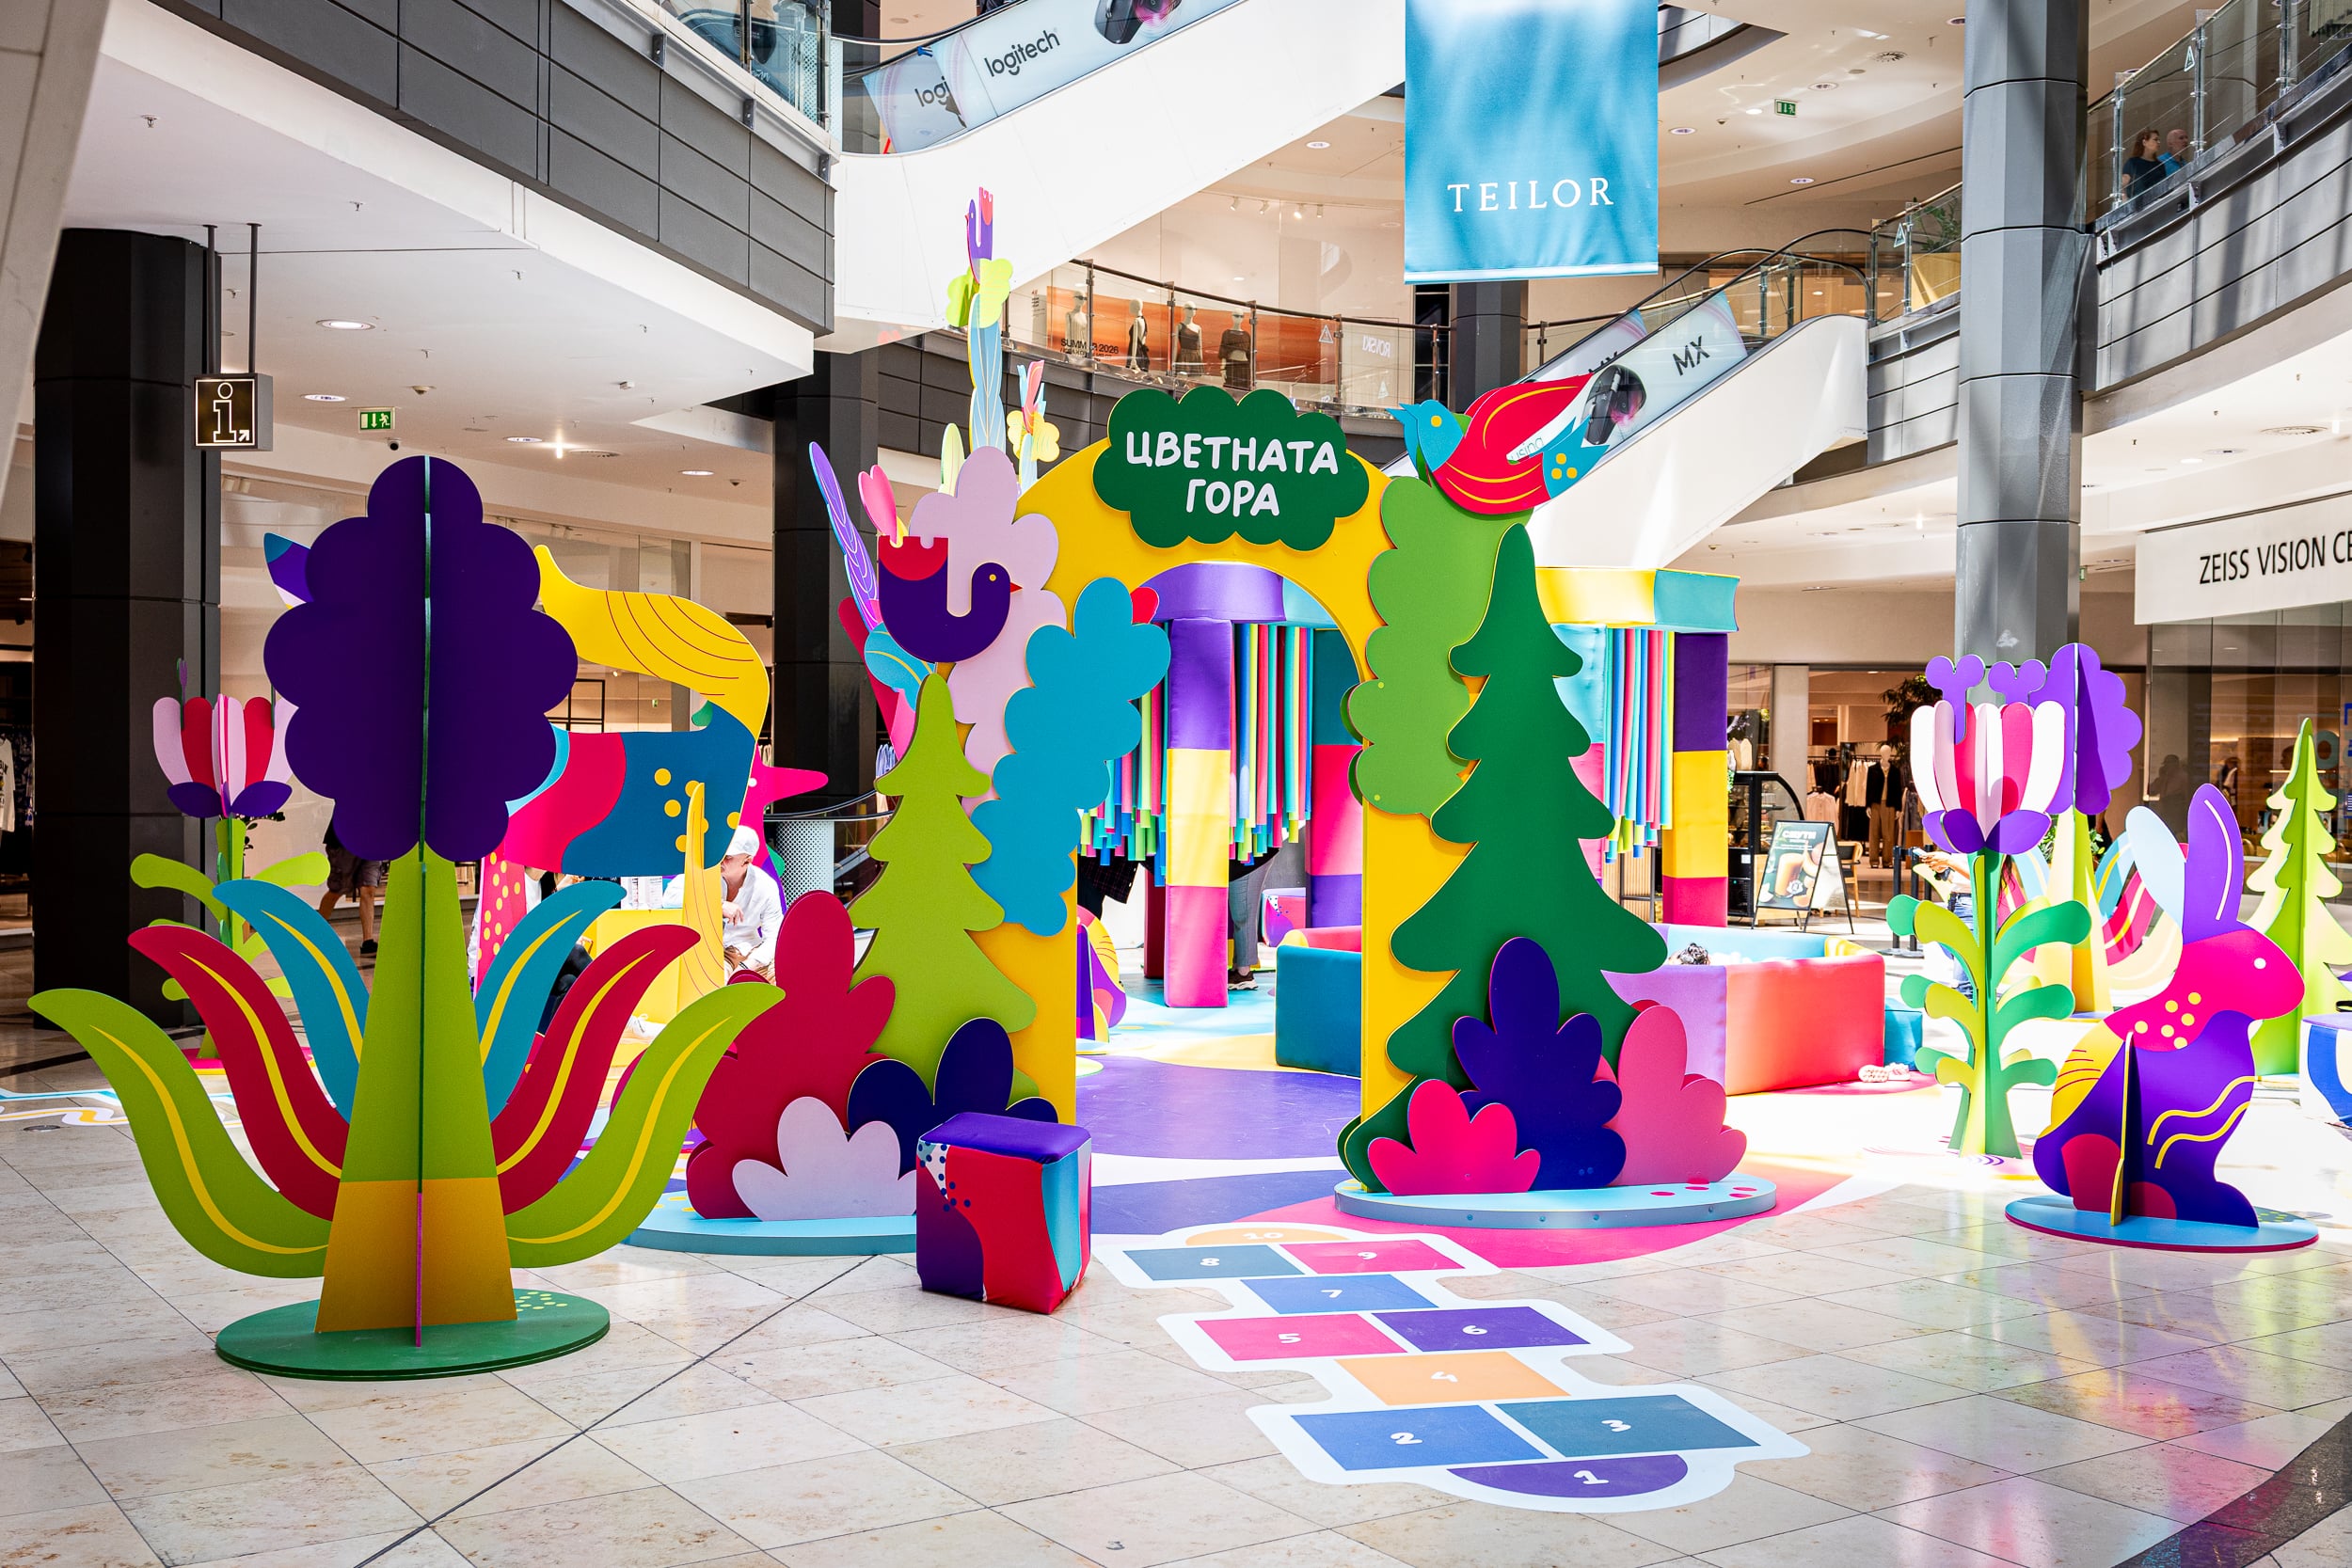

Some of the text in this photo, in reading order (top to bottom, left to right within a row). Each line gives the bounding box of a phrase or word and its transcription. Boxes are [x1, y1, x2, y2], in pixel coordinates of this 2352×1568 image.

[984, 29, 1060, 77] logitech
[1447, 177, 1614, 213] TEILOR
[1060, 338, 1098, 352] SUMMR
[1099, 344, 1119, 355] 2026
[1672, 335, 1710, 376] MX
[1126, 431, 1339, 475] ЦВЕТНАТА
[1185, 478, 1279, 517] ГОРА
[2200, 548, 2249, 584] ZEISS
[2257, 535, 2326, 576] VISION
[1200, 1258, 1220, 1267] 8
[1357, 1251, 1377, 1260] 9
[1320, 1289, 1343, 1298] 7
[1462, 1324, 1488, 1335] 6
[1278, 1333, 1302, 1344] 5
[1430, 1370, 1458, 1383] 4
[1601, 1419, 1631, 1433] 3
[1390, 1432, 1423, 1445] 2
[1573, 1469, 1610, 1485] 1
